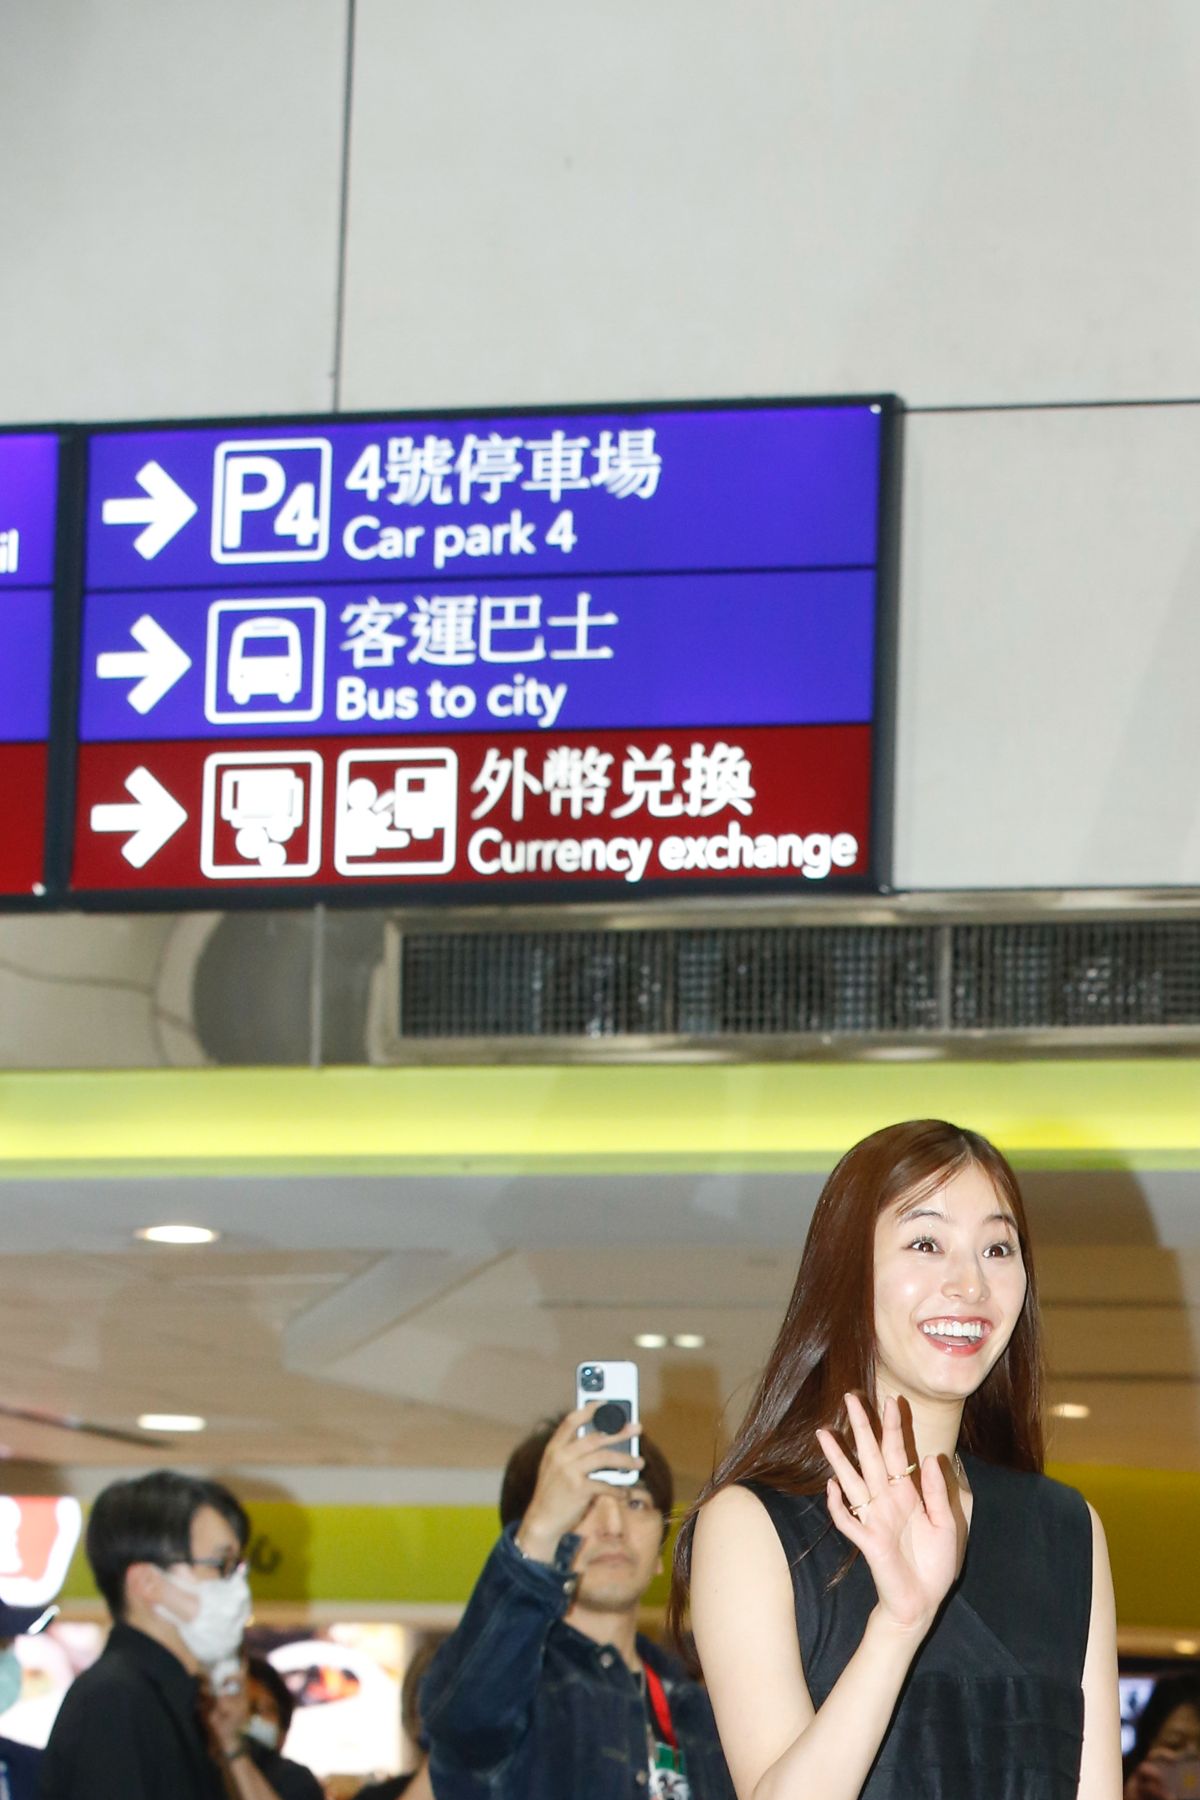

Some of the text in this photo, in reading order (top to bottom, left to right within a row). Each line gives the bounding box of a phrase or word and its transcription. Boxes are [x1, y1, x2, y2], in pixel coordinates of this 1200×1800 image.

[222, 454, 321, 549] P4
[343, 428, 663, 507] 4號停車場
[342, 509, 579, 571] Car park 4
[339, 591, 620, 672] 客運巴士
[335, 673, 569, 729] Bus to city
[467, 822, 860, 883] Currency exchange
